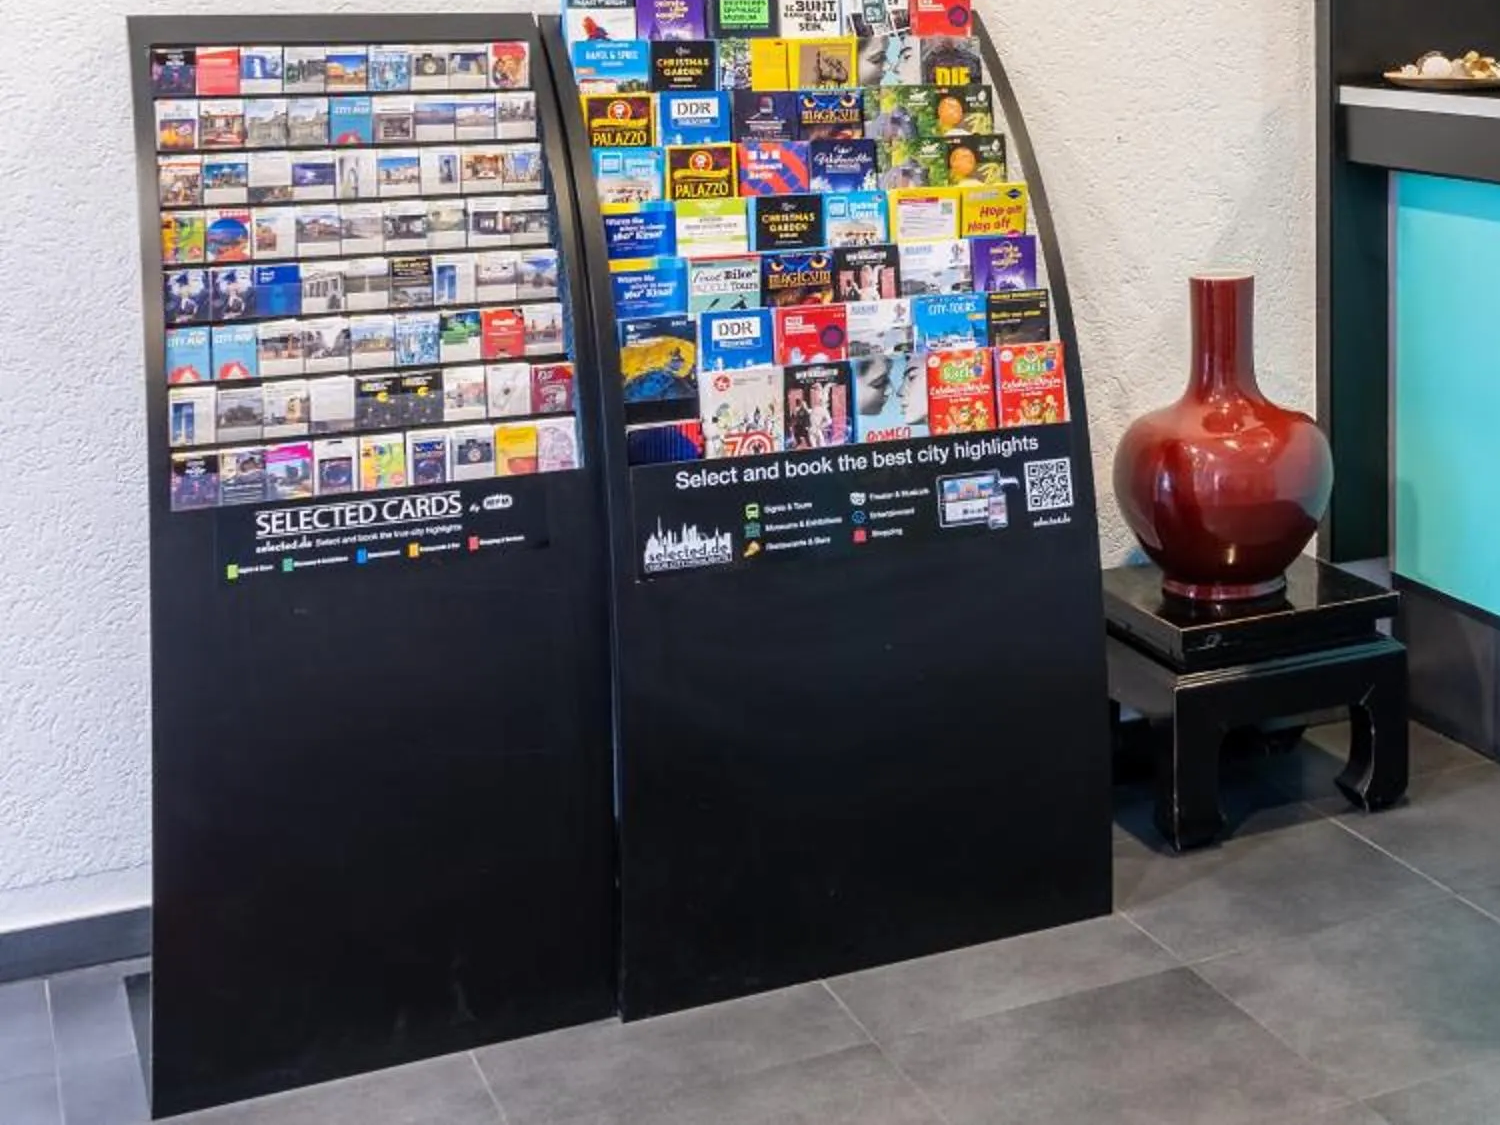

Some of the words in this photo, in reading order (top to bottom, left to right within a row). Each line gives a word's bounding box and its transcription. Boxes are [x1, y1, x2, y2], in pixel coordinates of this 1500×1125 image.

[676, 101, 712, 116] DDR
[593, 130, 647, 146] PALAZZO
[675, 182, 728, 198] PALAZZO
[762, 212, 815, 222] CHRISTMAS
[769, 222, 808, 232] GARDEN
[718, 321, 753, 336] DDR
[675, 468, 738, 489] Select
[743, 462, 779, 482] and
[785, 457, 833, 475] book
[837, 454, 867, 471] the
[872, 449, 913, 468] best
[917, 444, 949, 464] city
[954, 436, 1039, 460] highlights
[256, 506, 377, 535] SELECTED
[382, 494, 462, 521] CARDS
